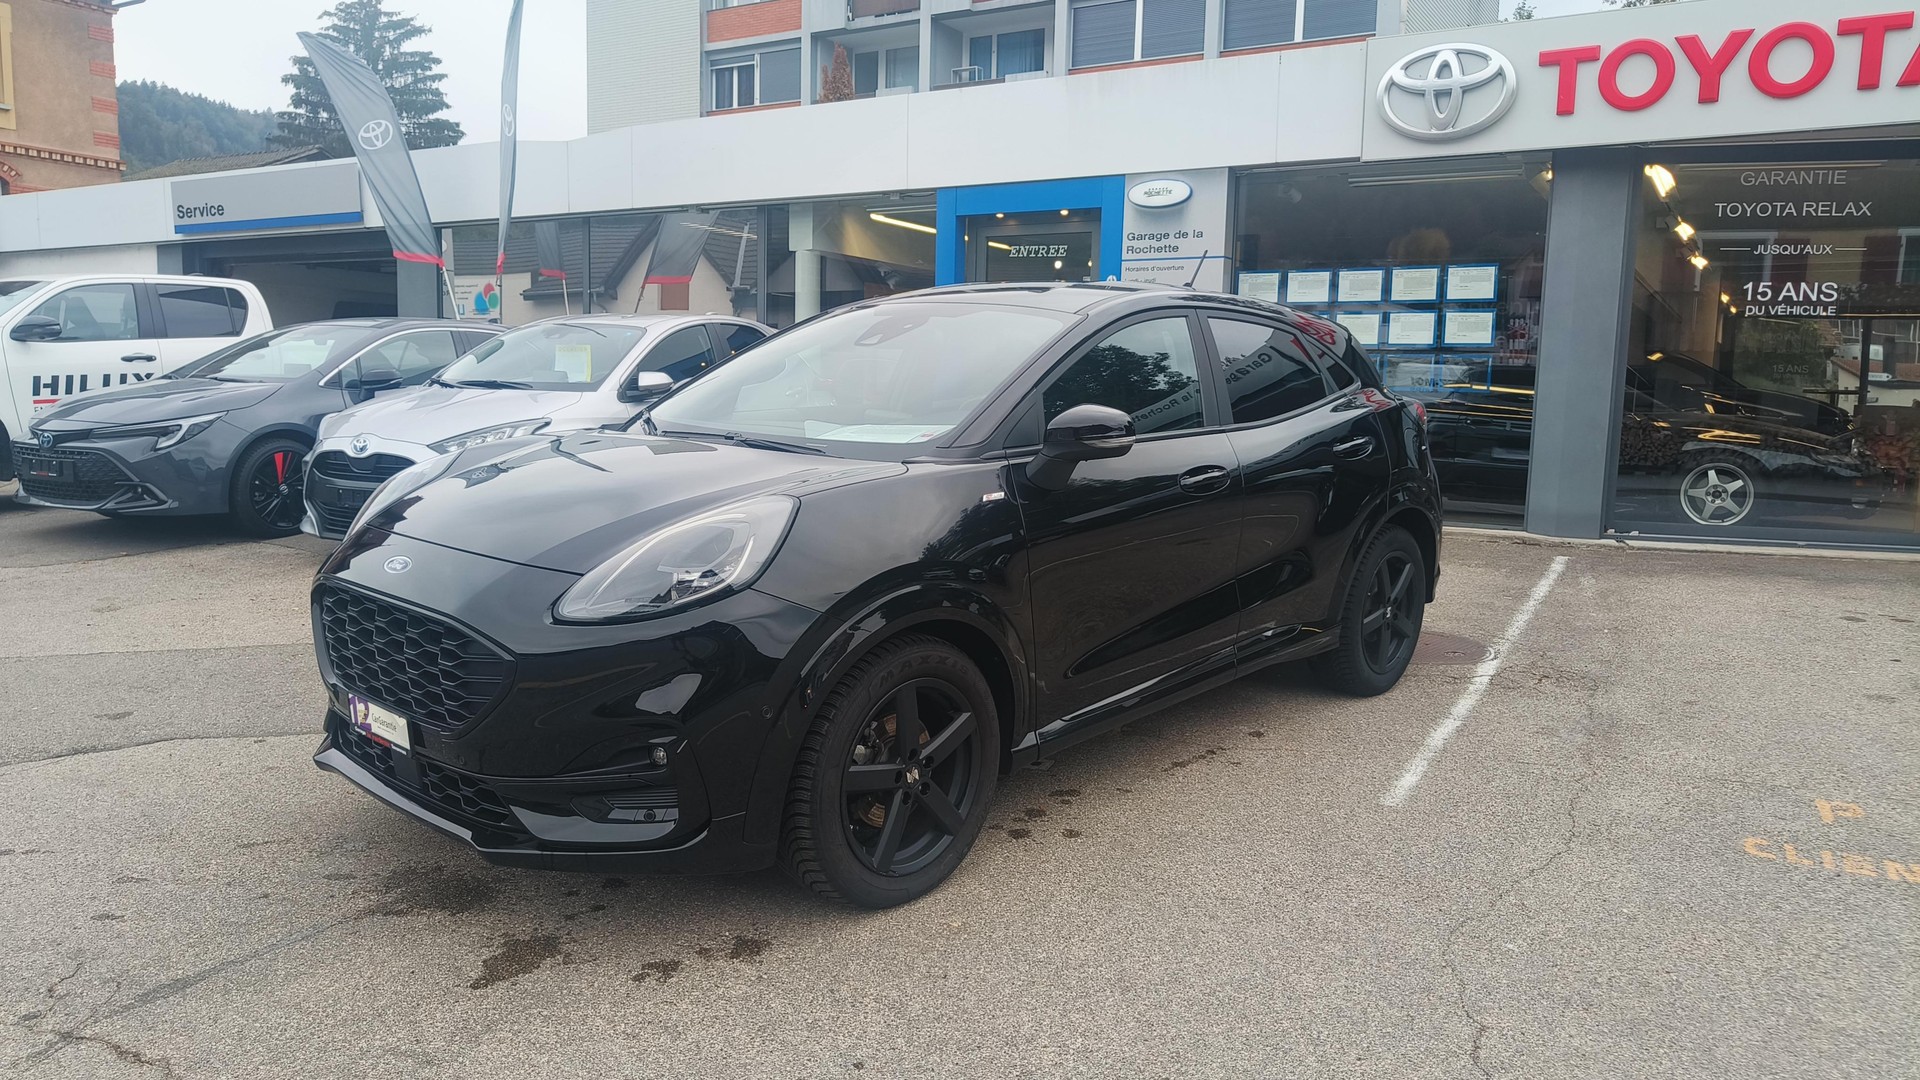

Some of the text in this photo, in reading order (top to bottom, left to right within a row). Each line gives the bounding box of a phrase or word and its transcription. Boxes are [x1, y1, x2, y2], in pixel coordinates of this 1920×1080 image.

[1740, 170, 1847, 186] GARANTIE
[176, 202, 225, 219] Service
[1714, 201, 1872, 217] TOYOTA RELAX
[1126, 229, 1204, 242] Garage de la
[1009, 245, 1068, 257] ENTREE
[1126, 244, 1179, 255] Rochette
[1753, 244, 1833, 255] JUSQU'AUX
[1150, 264, 1185, 272] d'ouverture
[1743, 281, 1838, 302] 15 ANS
[1745, 303, 1837, 316] DU VÉHICULE
[878, 654, 969, 689] MAXXIS
[1815, 797, 1865, 825] P
